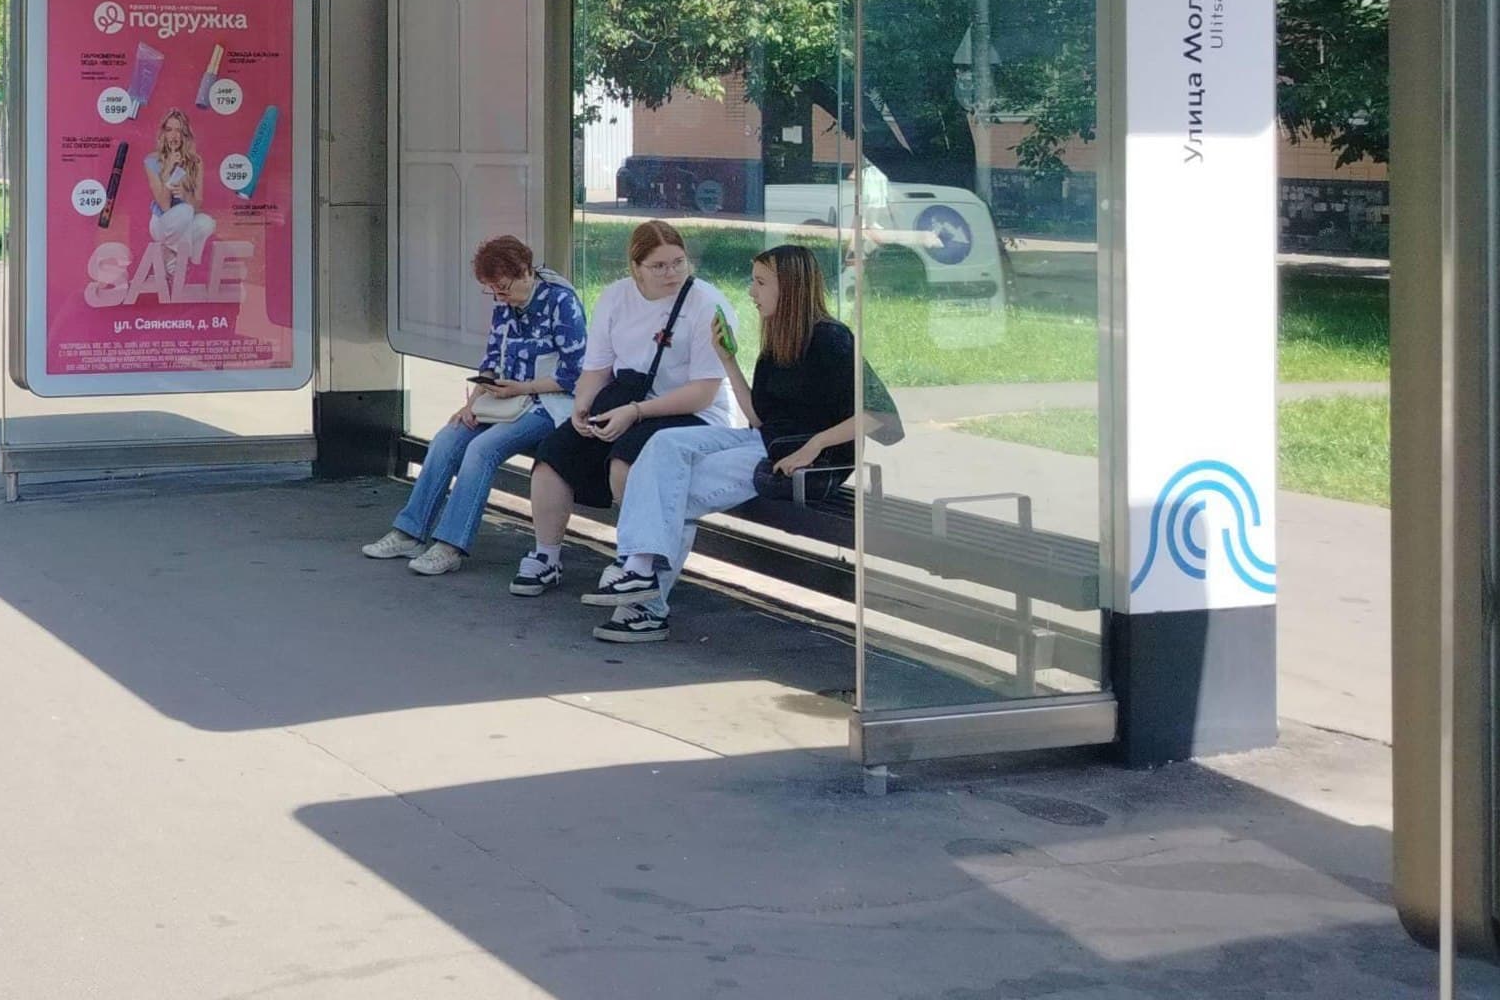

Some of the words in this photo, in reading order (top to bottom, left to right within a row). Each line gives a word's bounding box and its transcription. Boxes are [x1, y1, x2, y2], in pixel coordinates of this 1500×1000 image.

[129, 11, 248, 38] подружка
[1183, 72, 1206, 163] Улица
[84, 241, 256, 308] SALE
[114, 320, 133, 333] ул.
[134, 318, 195, 331] Саянская,
[197, 319, 209, 331] д.
[211, 316, 228, 329] 8А
